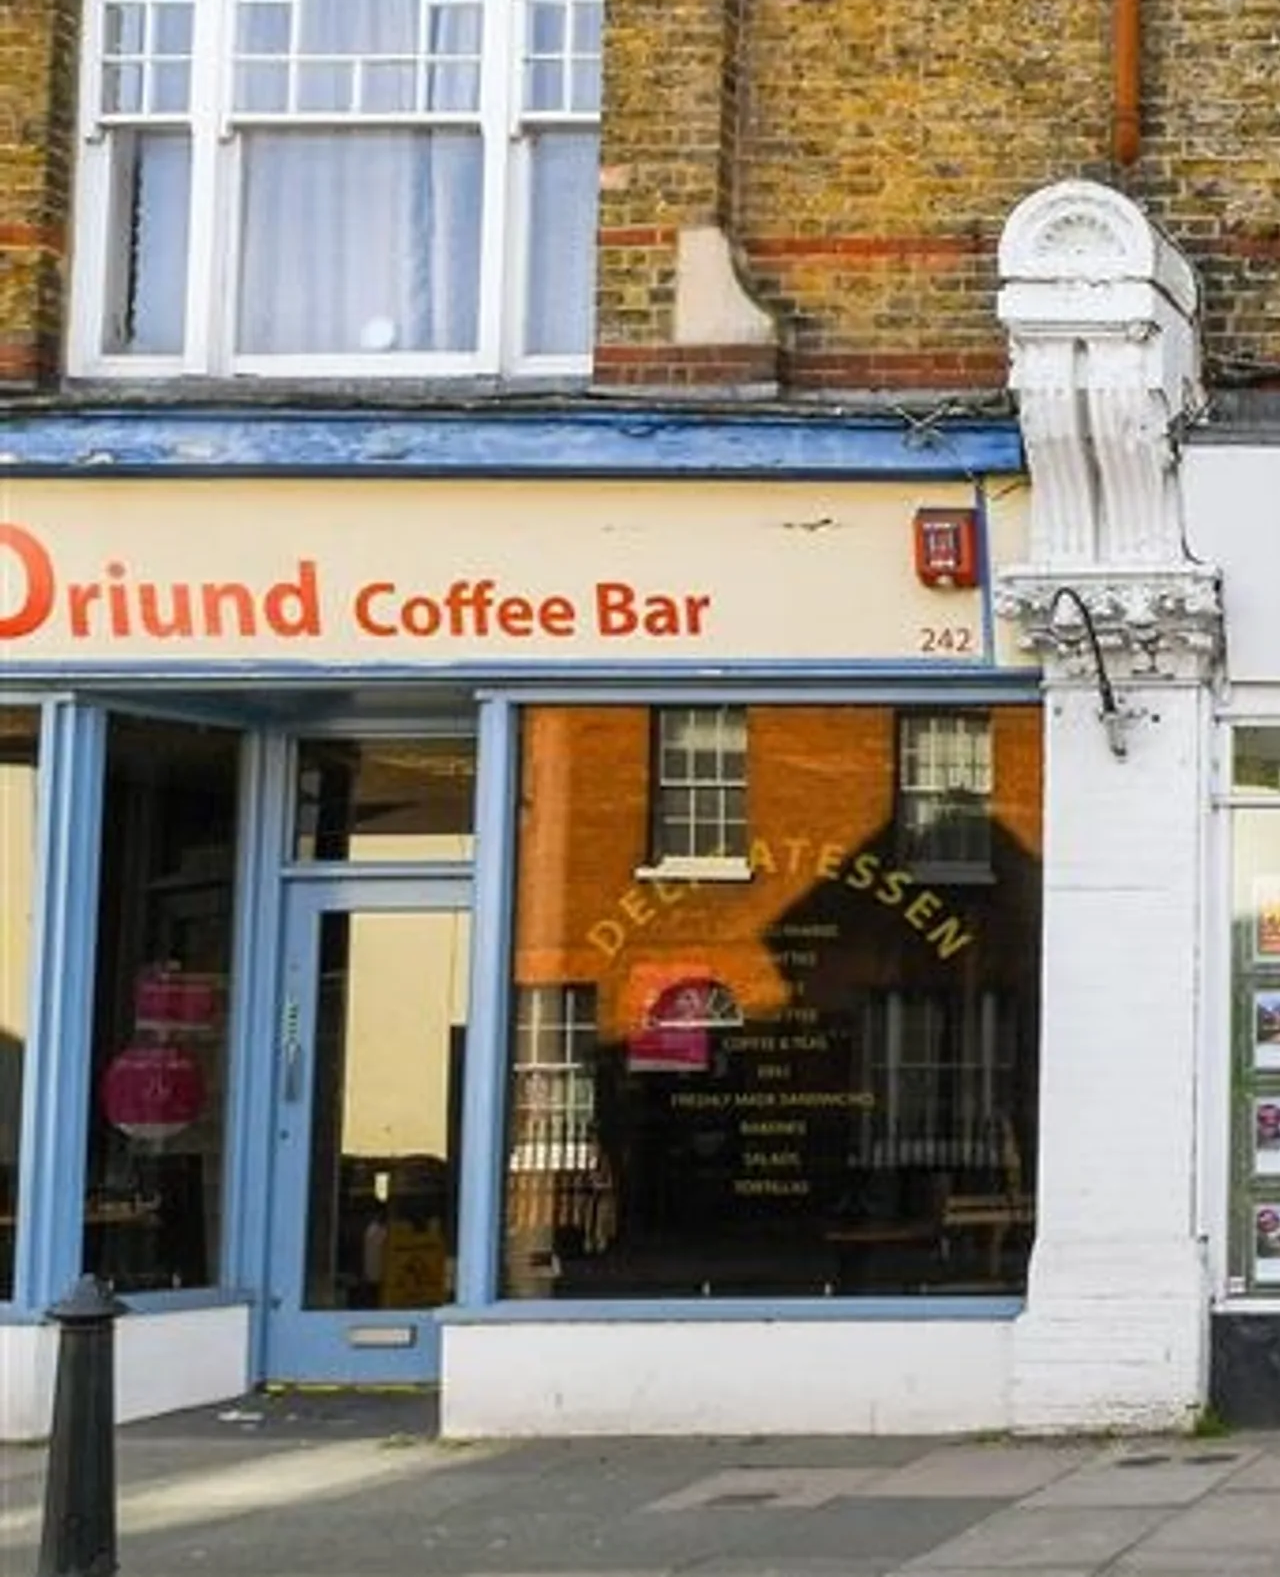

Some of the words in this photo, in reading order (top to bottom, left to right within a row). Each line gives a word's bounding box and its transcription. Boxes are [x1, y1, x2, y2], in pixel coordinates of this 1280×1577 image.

[355, 580, 575, 637] Coffee
[595, 582, 711, 637] Bar
[919, 626, 973, 653] 242
[584, 838, 974, 961] DELATESSEN
